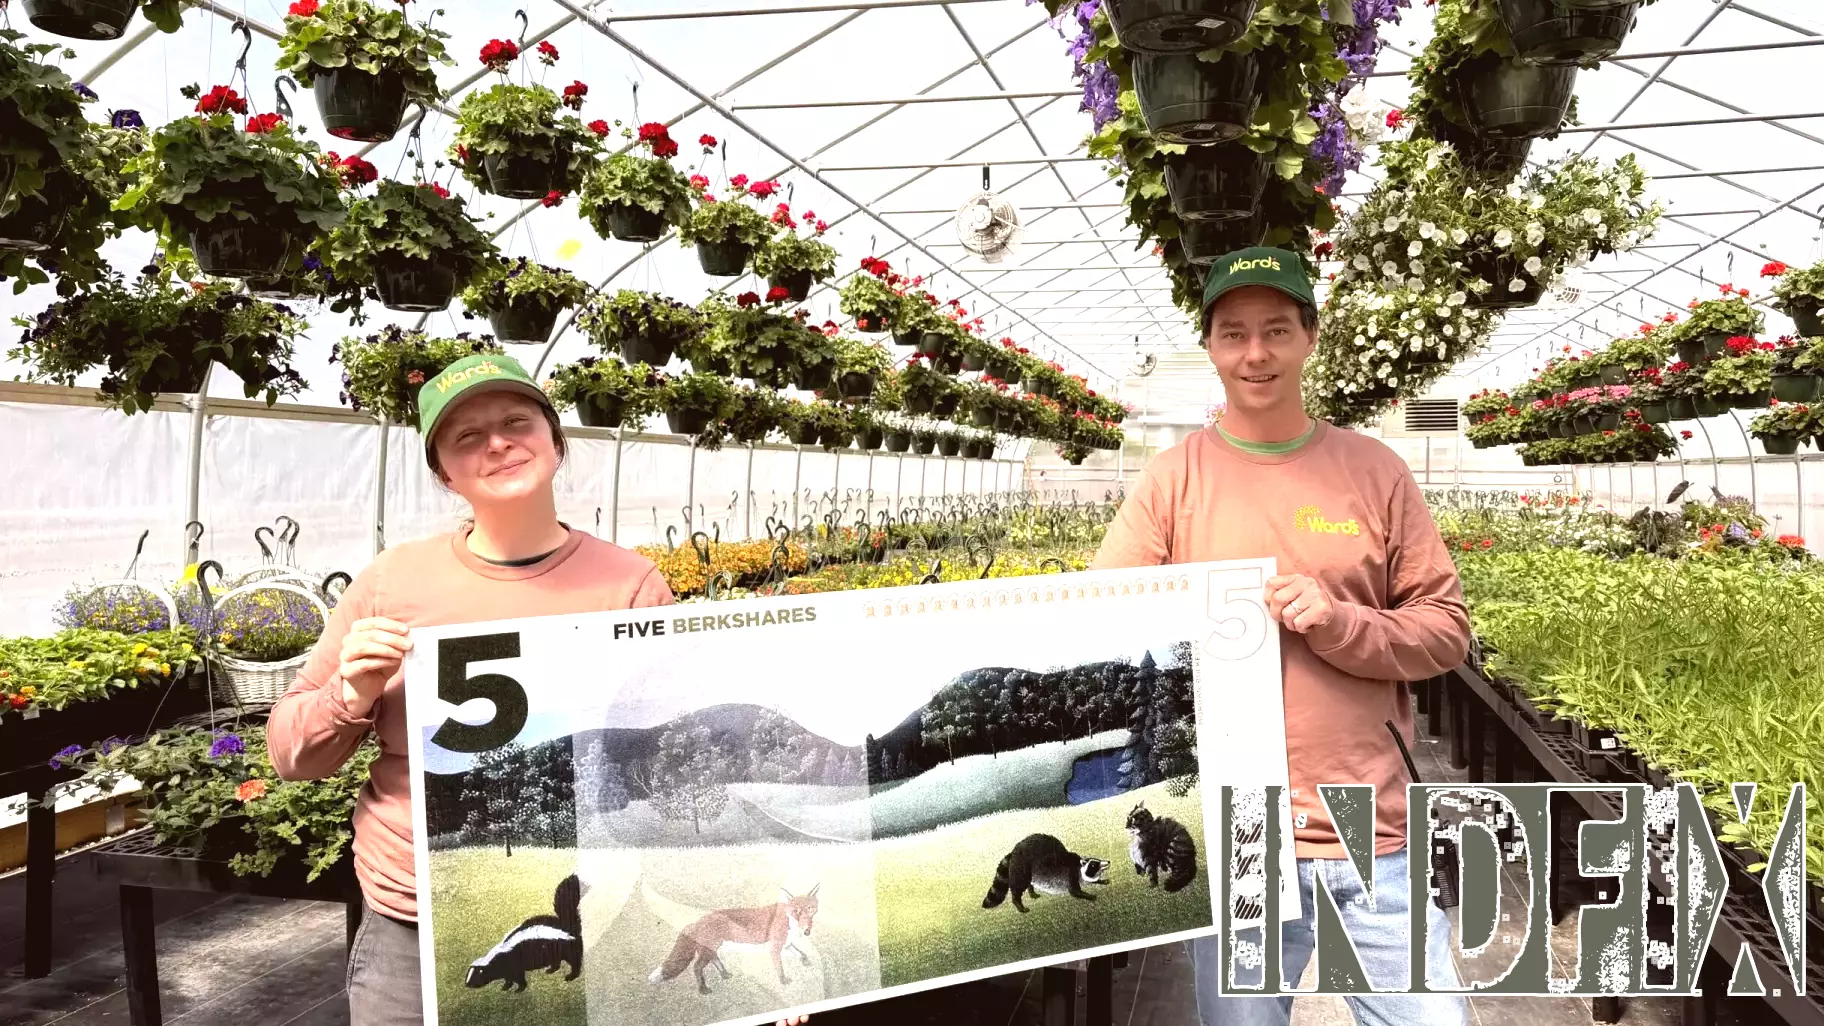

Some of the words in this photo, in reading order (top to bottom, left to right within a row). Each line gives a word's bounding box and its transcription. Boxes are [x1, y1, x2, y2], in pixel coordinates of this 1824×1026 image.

[613, 619, 665, 640] FIVE
[672, 606, 818, 635] BERKSHARES
[1203, 566, 1268, 662] 5
[430, 631, 529, 754] 5
